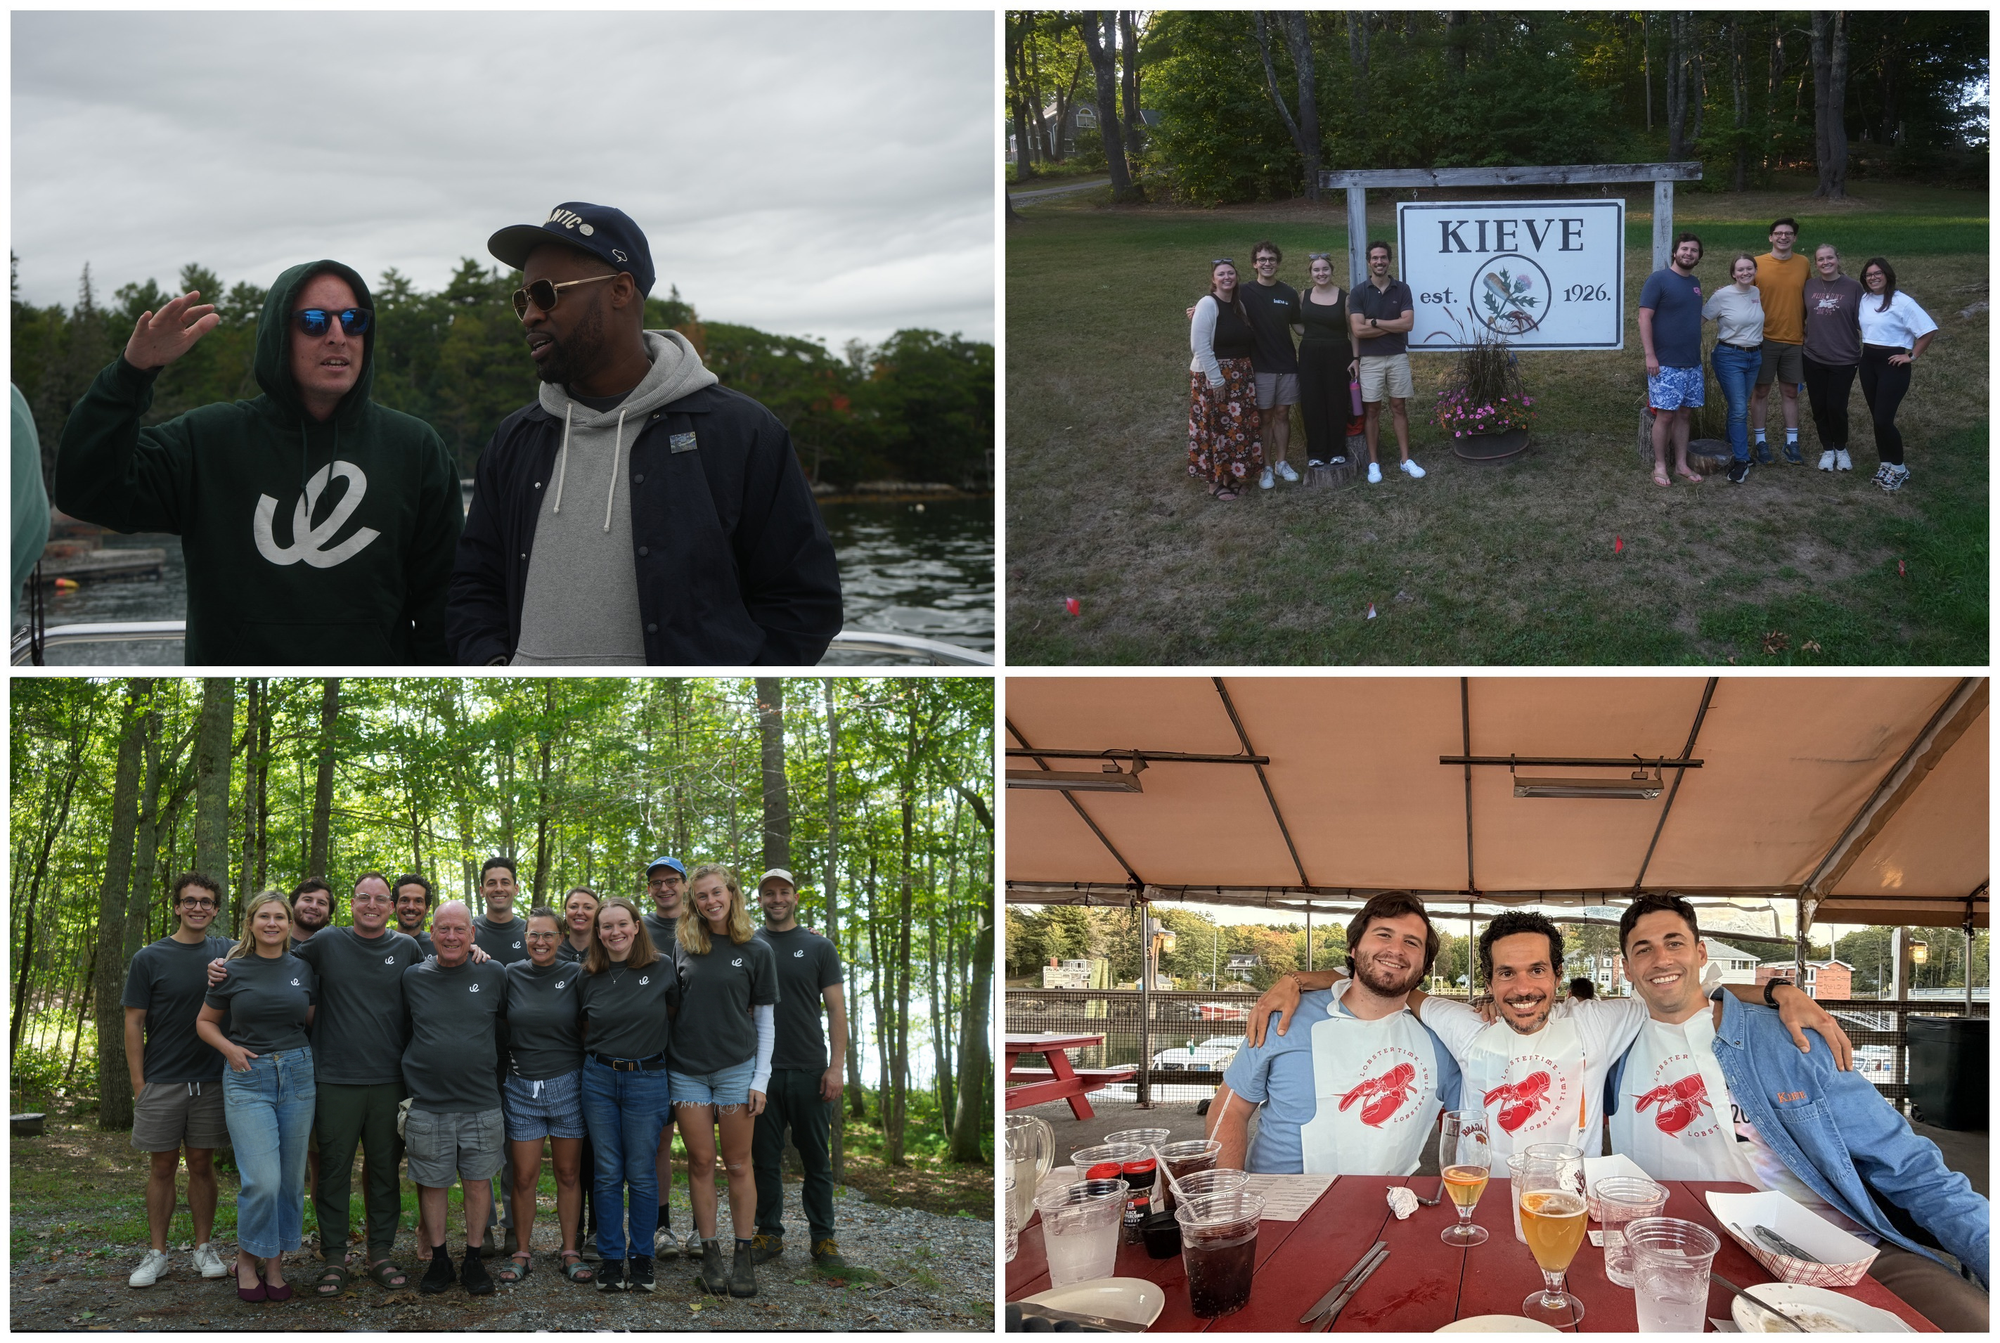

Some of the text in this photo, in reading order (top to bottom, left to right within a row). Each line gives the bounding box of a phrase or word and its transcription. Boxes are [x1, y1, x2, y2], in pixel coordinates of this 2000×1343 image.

[1438, 218, 1584, 253] KIEVE
[1420, 282, 1612, 304] est. 1926.
[1360, 1046, 1419, 1077] LOBSTER TIME
[1534, 1054, 1558, 1070] TIME
[1654, 1054, 1689, 1081] LOBSTER
[1393, 1095, 1425, 1123] LOBSTER
[1523, 1105, 1561, 1132] LOBSTER
